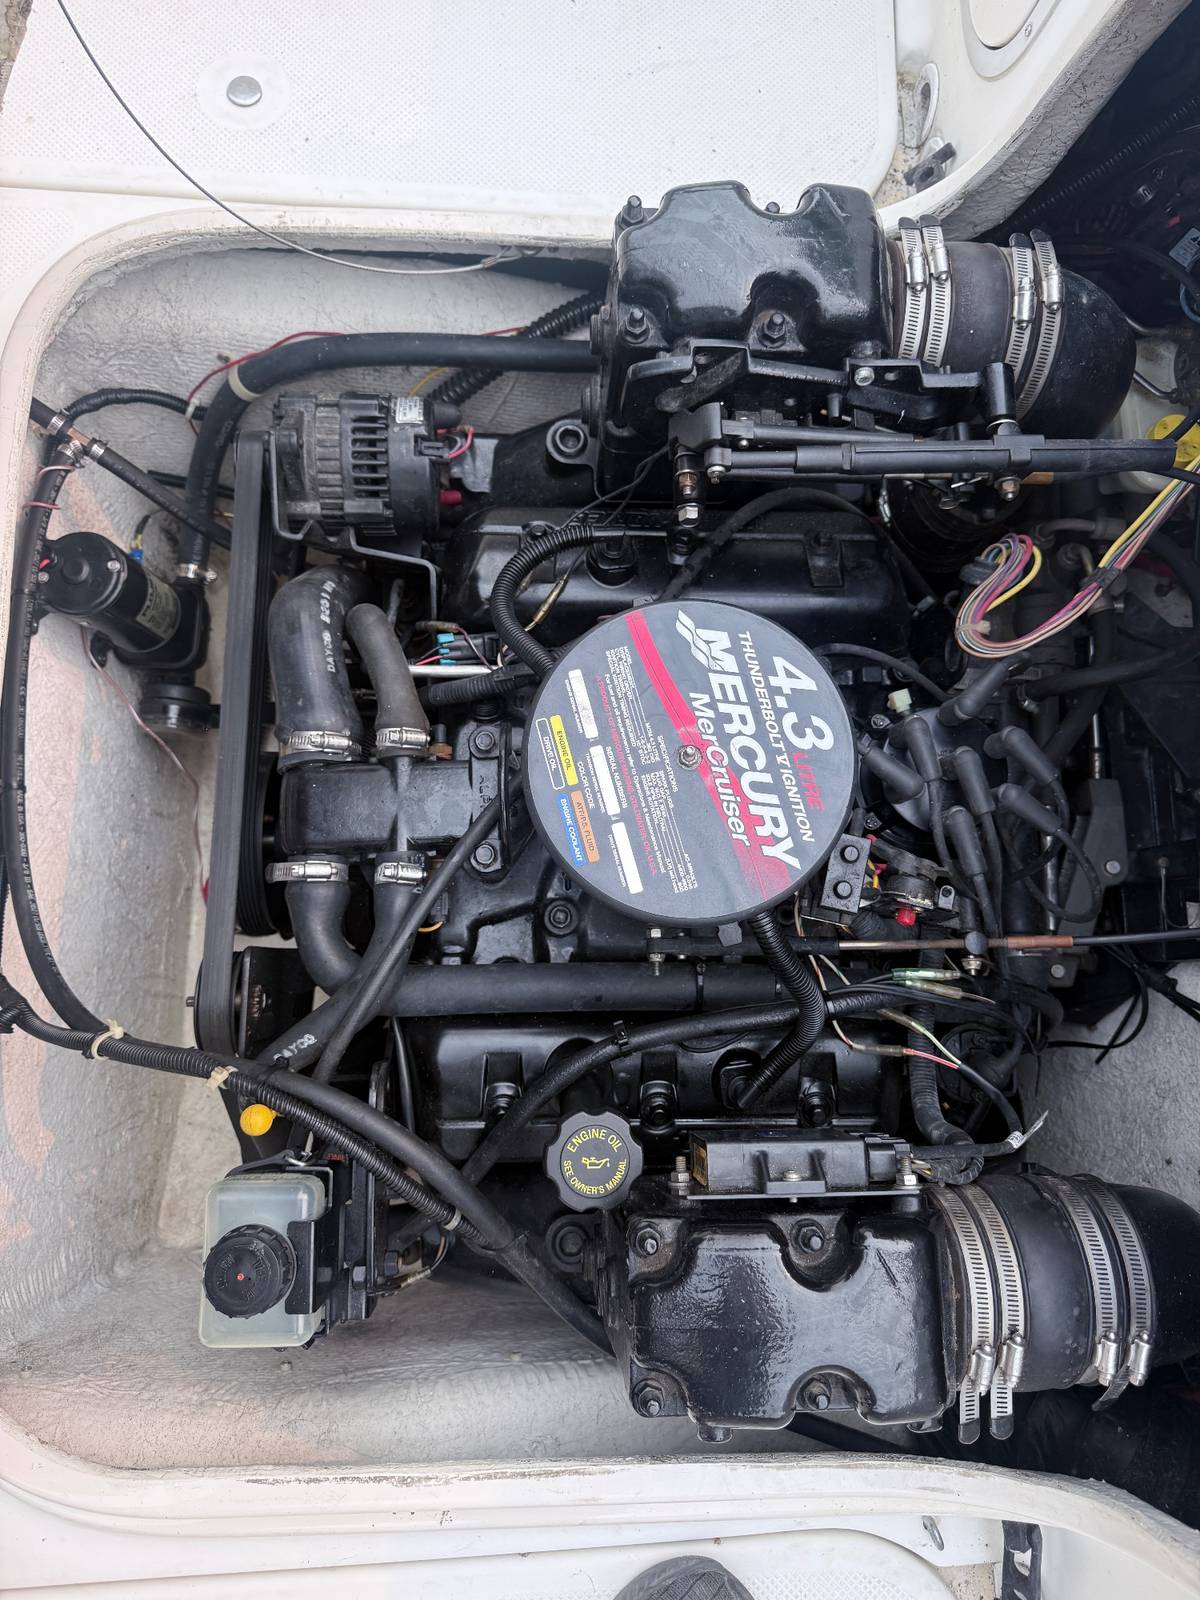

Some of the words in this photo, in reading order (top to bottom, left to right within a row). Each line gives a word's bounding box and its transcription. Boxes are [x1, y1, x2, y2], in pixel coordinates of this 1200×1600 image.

[321, 630, 336, 673] DAYCO
[768, 656, 833, 750] 4.3
[542, 736, 553, 757] DRIVE
[549, 758, 557, 770] OIL
[556, 730, 568, 757] ENGINE
[564, 757, 572, 770] OIL
[656, 734, 678, 792] SPECIFICATIONS
[695, 629, 801, 869] MERCURY
[738, 630, 786, 750] THUNDERBOLT
[779, 770, 814, 841] IGNITION
[577, 761, 589, 787] COLOR
[584, 787, 595, 809] CODE
[605, 746, 617, 772] SERIAL
[613, 774, 628, 808] NUMBERS
[615, 715, 630, 753] requirements
[632, 775, 646, 807] Operations
[644, 812, 659, 850] Maintenance
[655, 851, 666, 873] Manual
[688, 693, 750, 845] MerCruiser
[792, 753, 824, 811] LITRE
[560, 798, 572, 825] ENGINE
[567, 826, 582, 861] COOLANT
[583, 830, 594, 851] FLUID
[567, 1128, 607, 1153] ENGINE
[607, 1135, 622, 1152] OIL
[563, 1160, 574, 1178] SEE
[570, 1176, 605, 1194] OWNER'S
[605, 1158, 627, 1191] MANUAL
